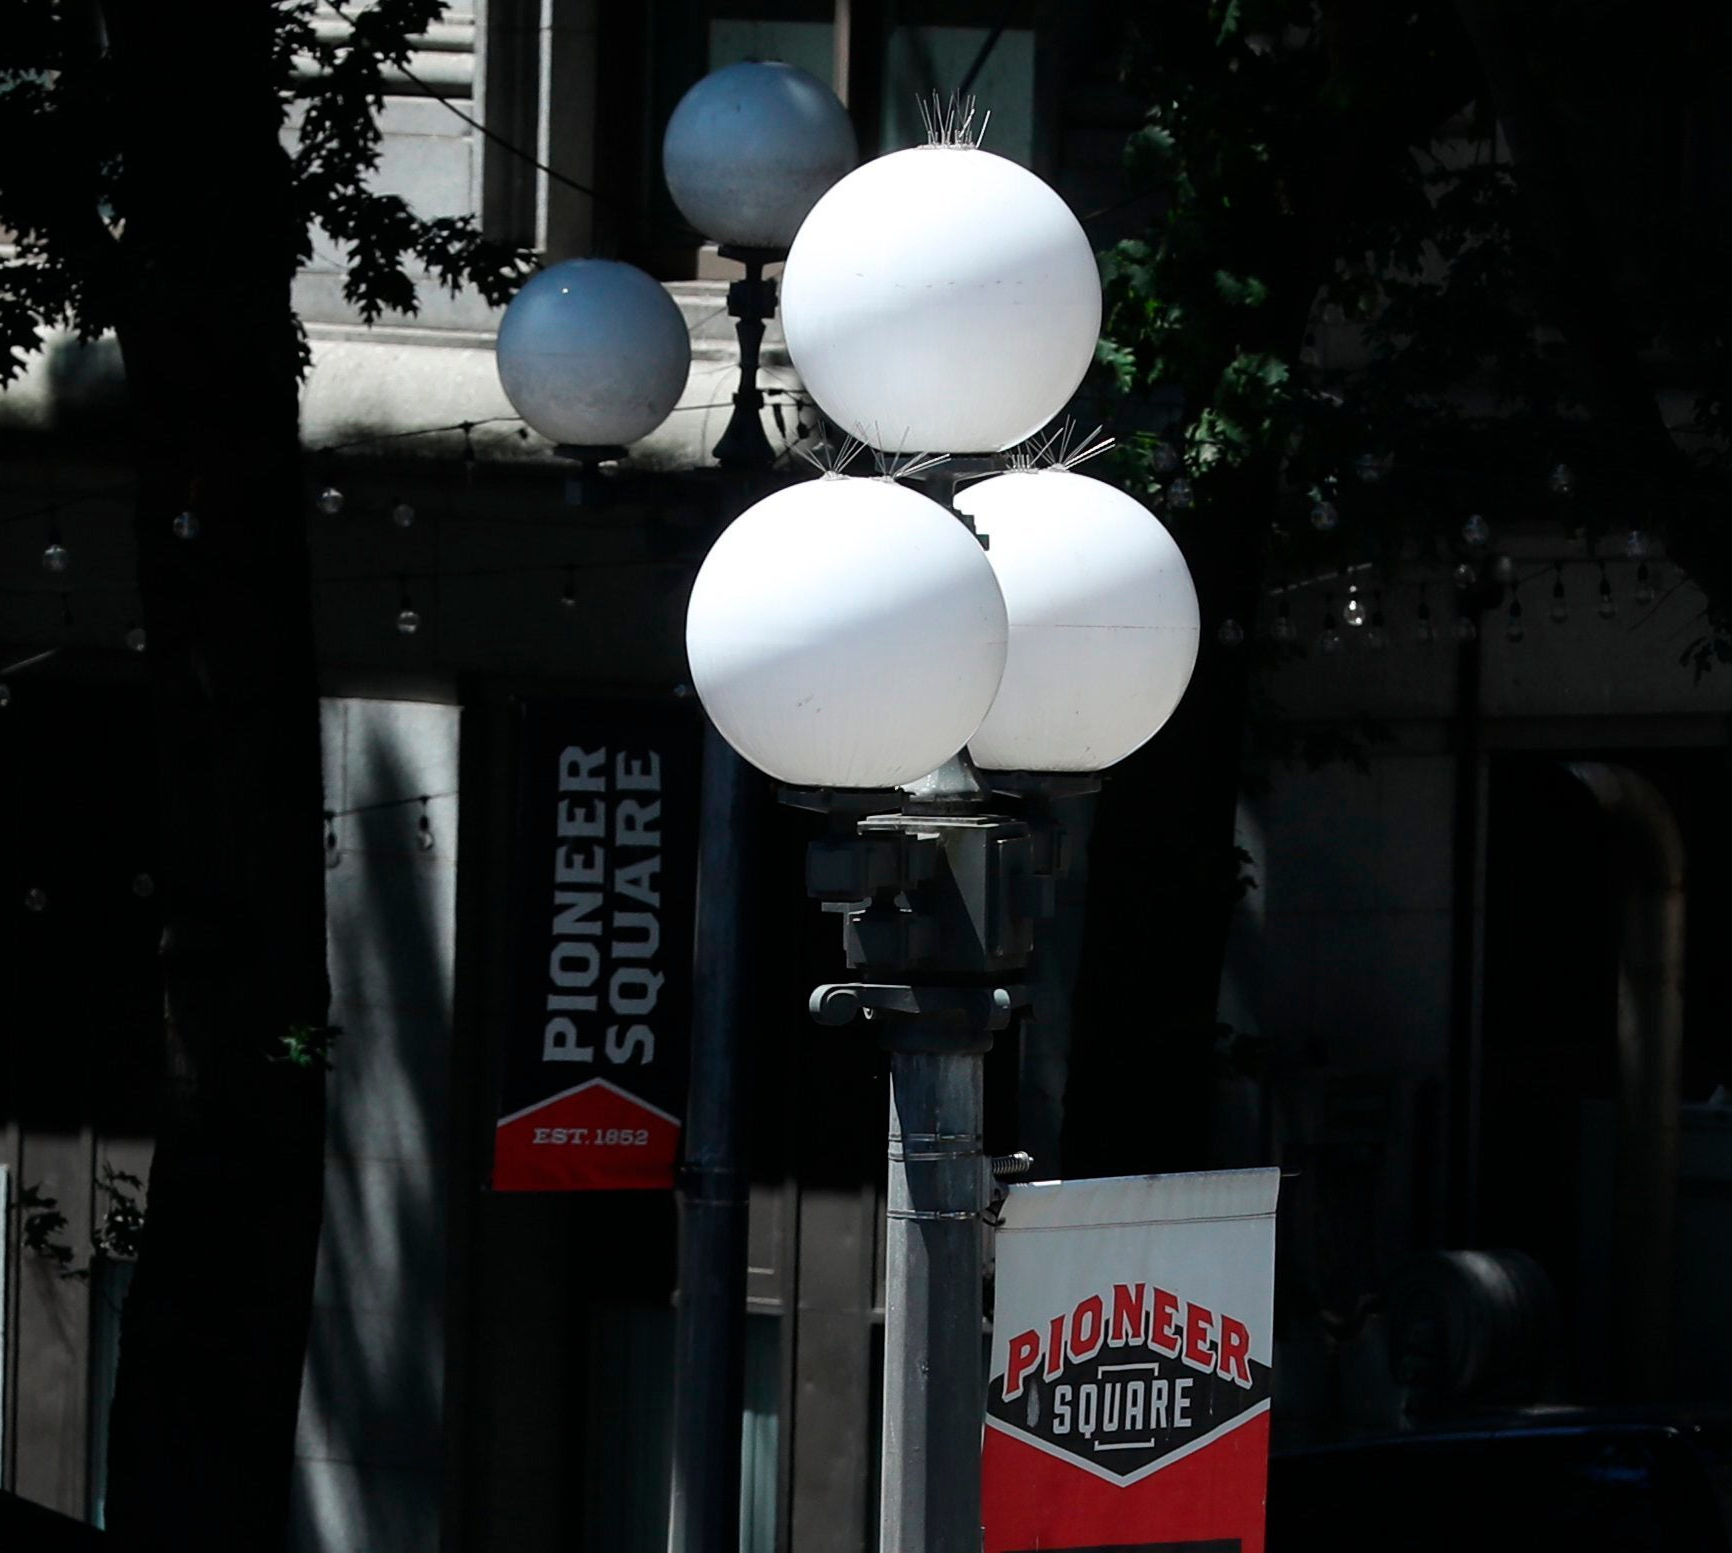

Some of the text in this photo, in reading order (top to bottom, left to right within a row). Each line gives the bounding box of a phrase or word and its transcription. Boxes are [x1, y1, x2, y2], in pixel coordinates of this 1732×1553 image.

[542, 745, 607, 1063] PIONEER
[604, 749, 665, 1065] SQUARE
[1002, 1282, 1253, 1402] PIONEER
[1052, 1378, 1194, 1439] SQUARE
